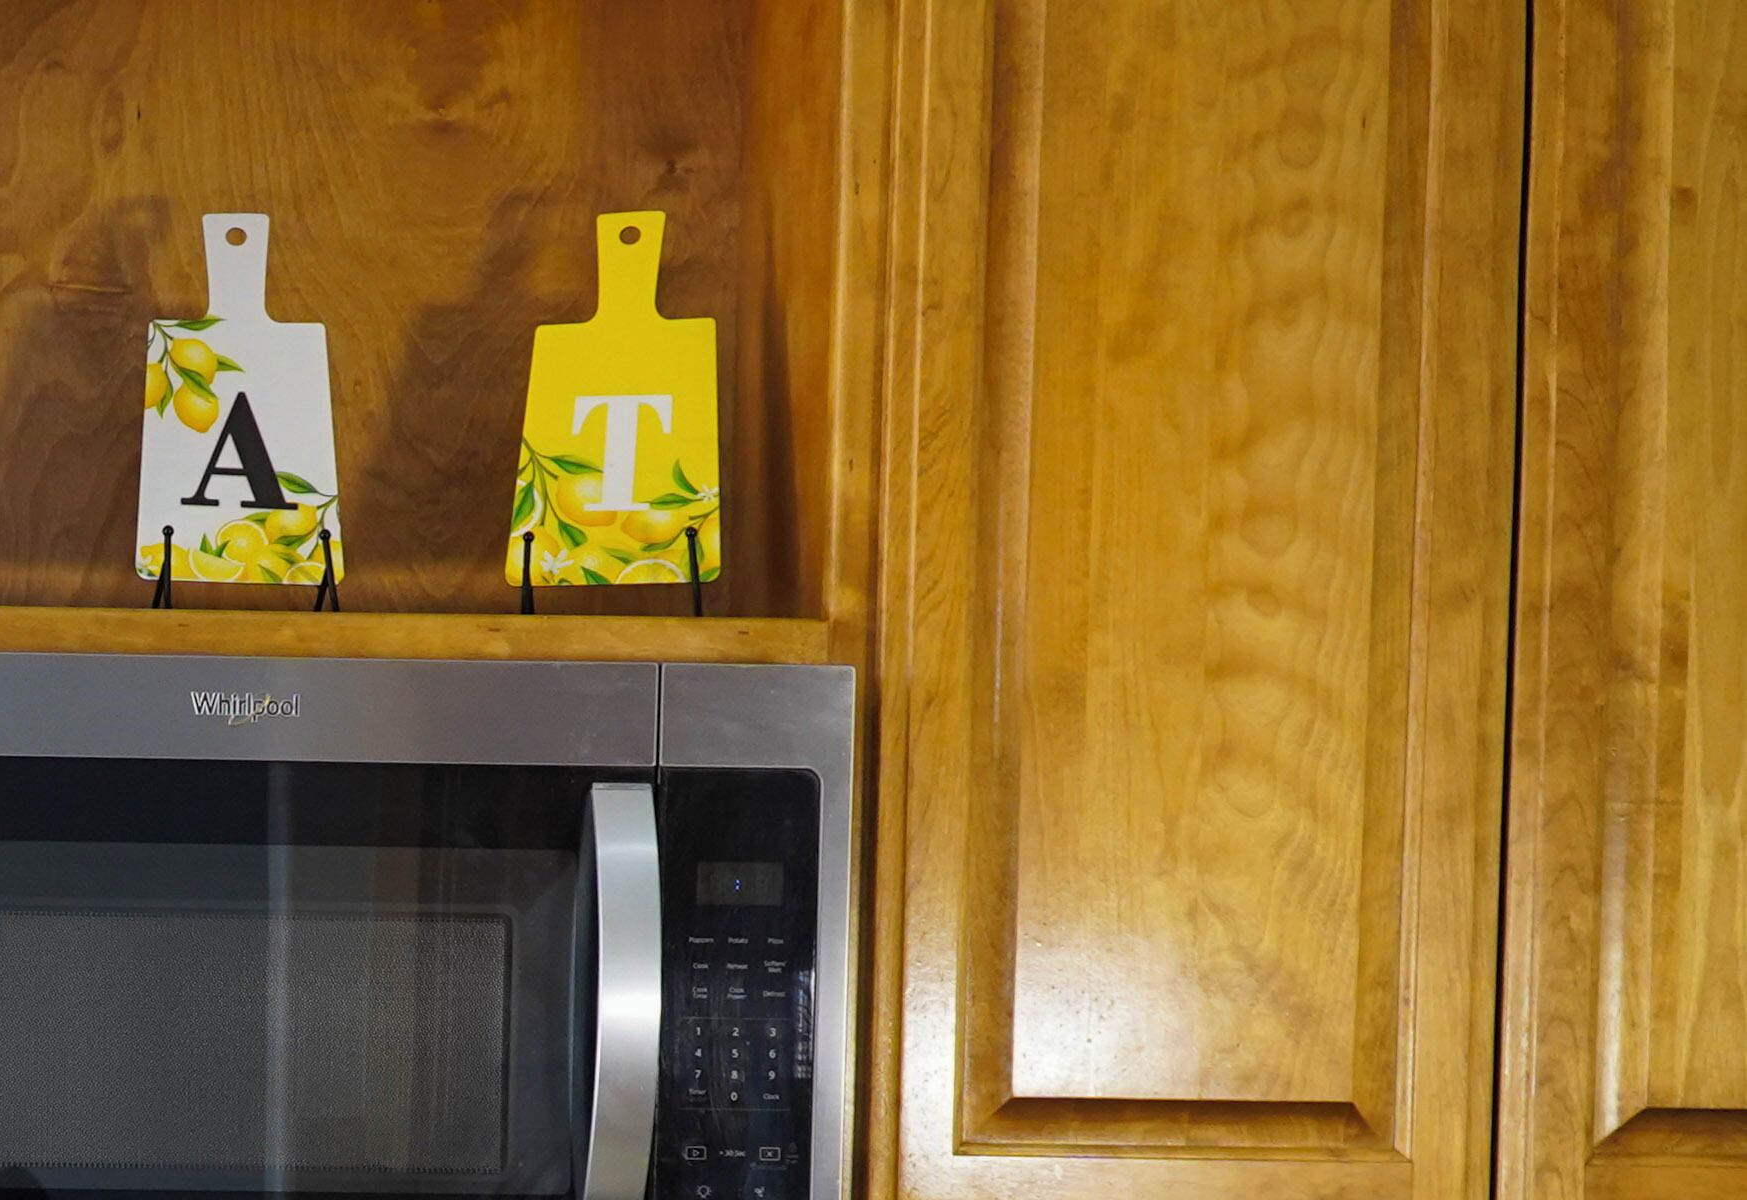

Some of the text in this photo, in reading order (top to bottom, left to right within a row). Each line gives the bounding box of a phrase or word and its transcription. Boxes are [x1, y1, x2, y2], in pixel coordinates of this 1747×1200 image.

[180, 391, 299, 510] A
[571, 394, 673, 512] T
[190, 691, 301, 722] Whirlpool
[695, 1027, 701, 1036] 1
[732, 1027, 740, 1037] 2
[769, 1027, 777, 1037] 3
[694, 1048, 702, 1057] 4
[731, 1048, 739, 1058] 5
[768, 1049, 776, 1059] 6
[694, 1070, 702, 1079] 7
[730, 1070, 738, 1080] 8
[768, 1070, 776, 1080] 9
[730, 1091, 738, 1101] 0
